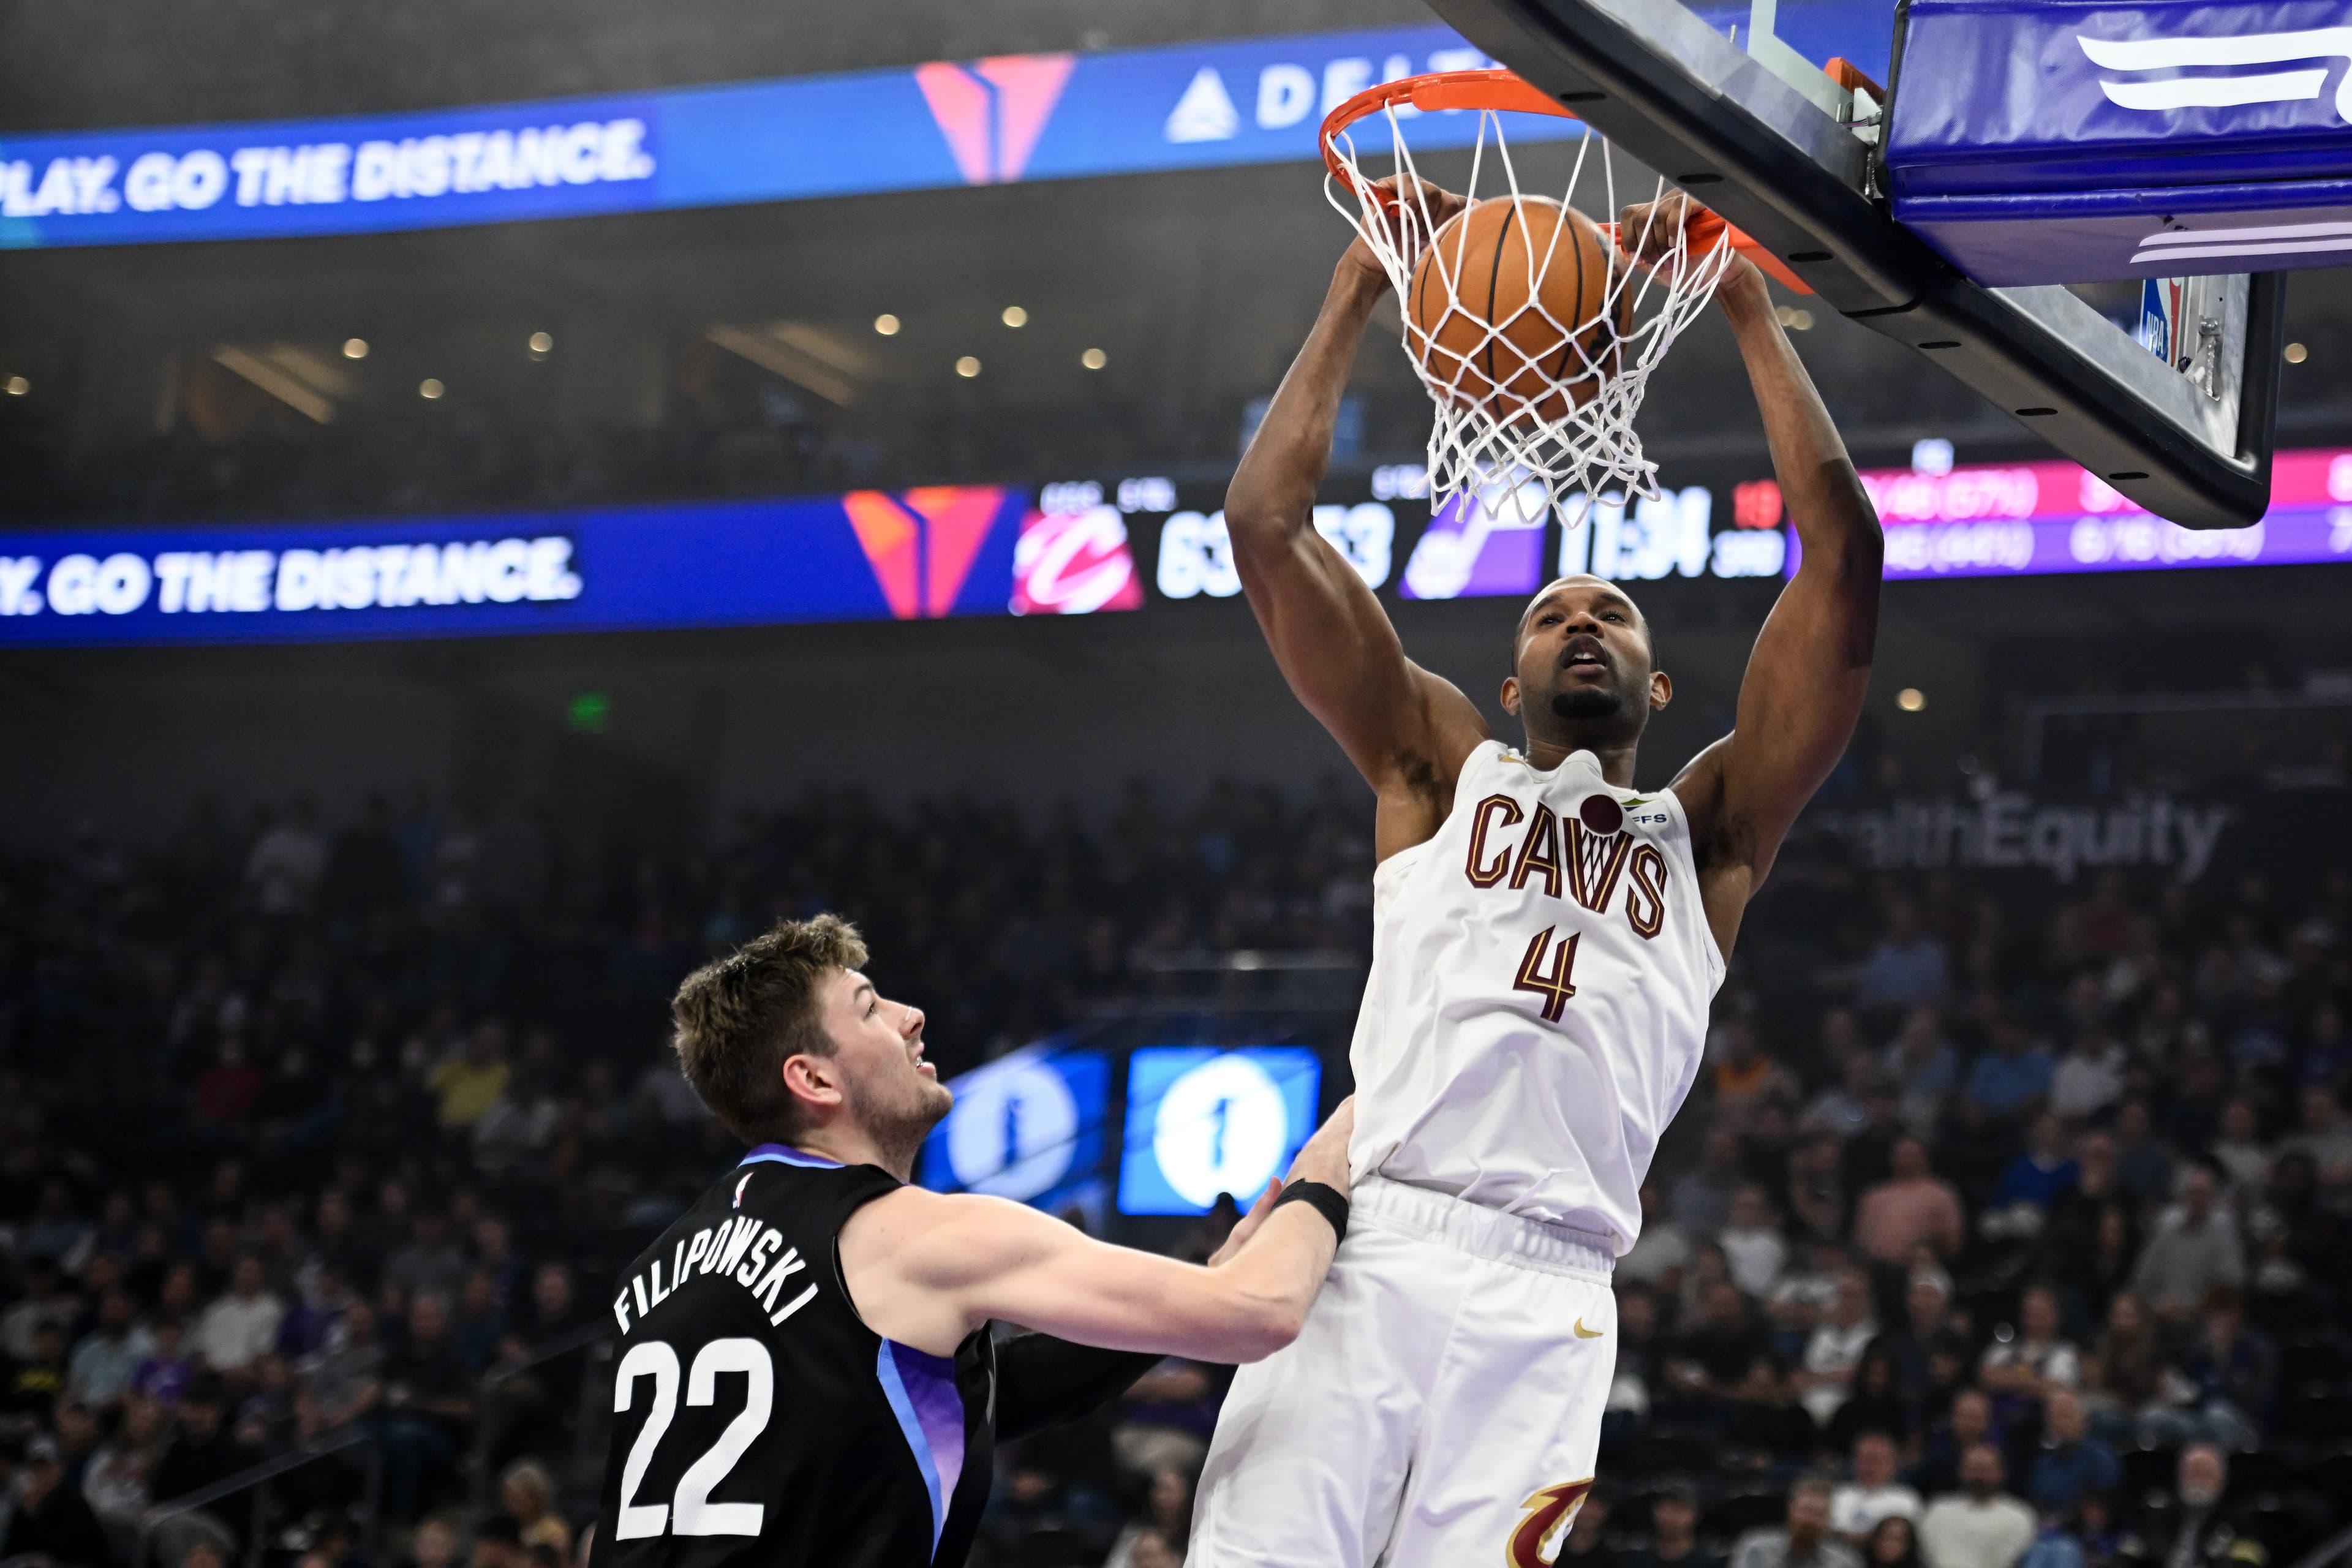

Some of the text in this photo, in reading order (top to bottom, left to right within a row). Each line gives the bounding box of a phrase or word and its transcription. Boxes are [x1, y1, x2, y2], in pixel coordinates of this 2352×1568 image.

[1256, 48, 1508, 130] DELT
[0, 118, 657, 217] LAY. GO THE DISTANCE.
[2146, 310, 2165, 355] NBA
[47, 552, 153, 616] GO
[154, 549, 276, 612] THE
[275, 536, 584, 611] DISTANCE.
[1464, 793, 1668, 941] CAVS
[1512, 924, 1581, 1023] 4
[613, 1215, 819, 1336] FILIPOWSKI
[613, 1337, 774, 1541] 22
